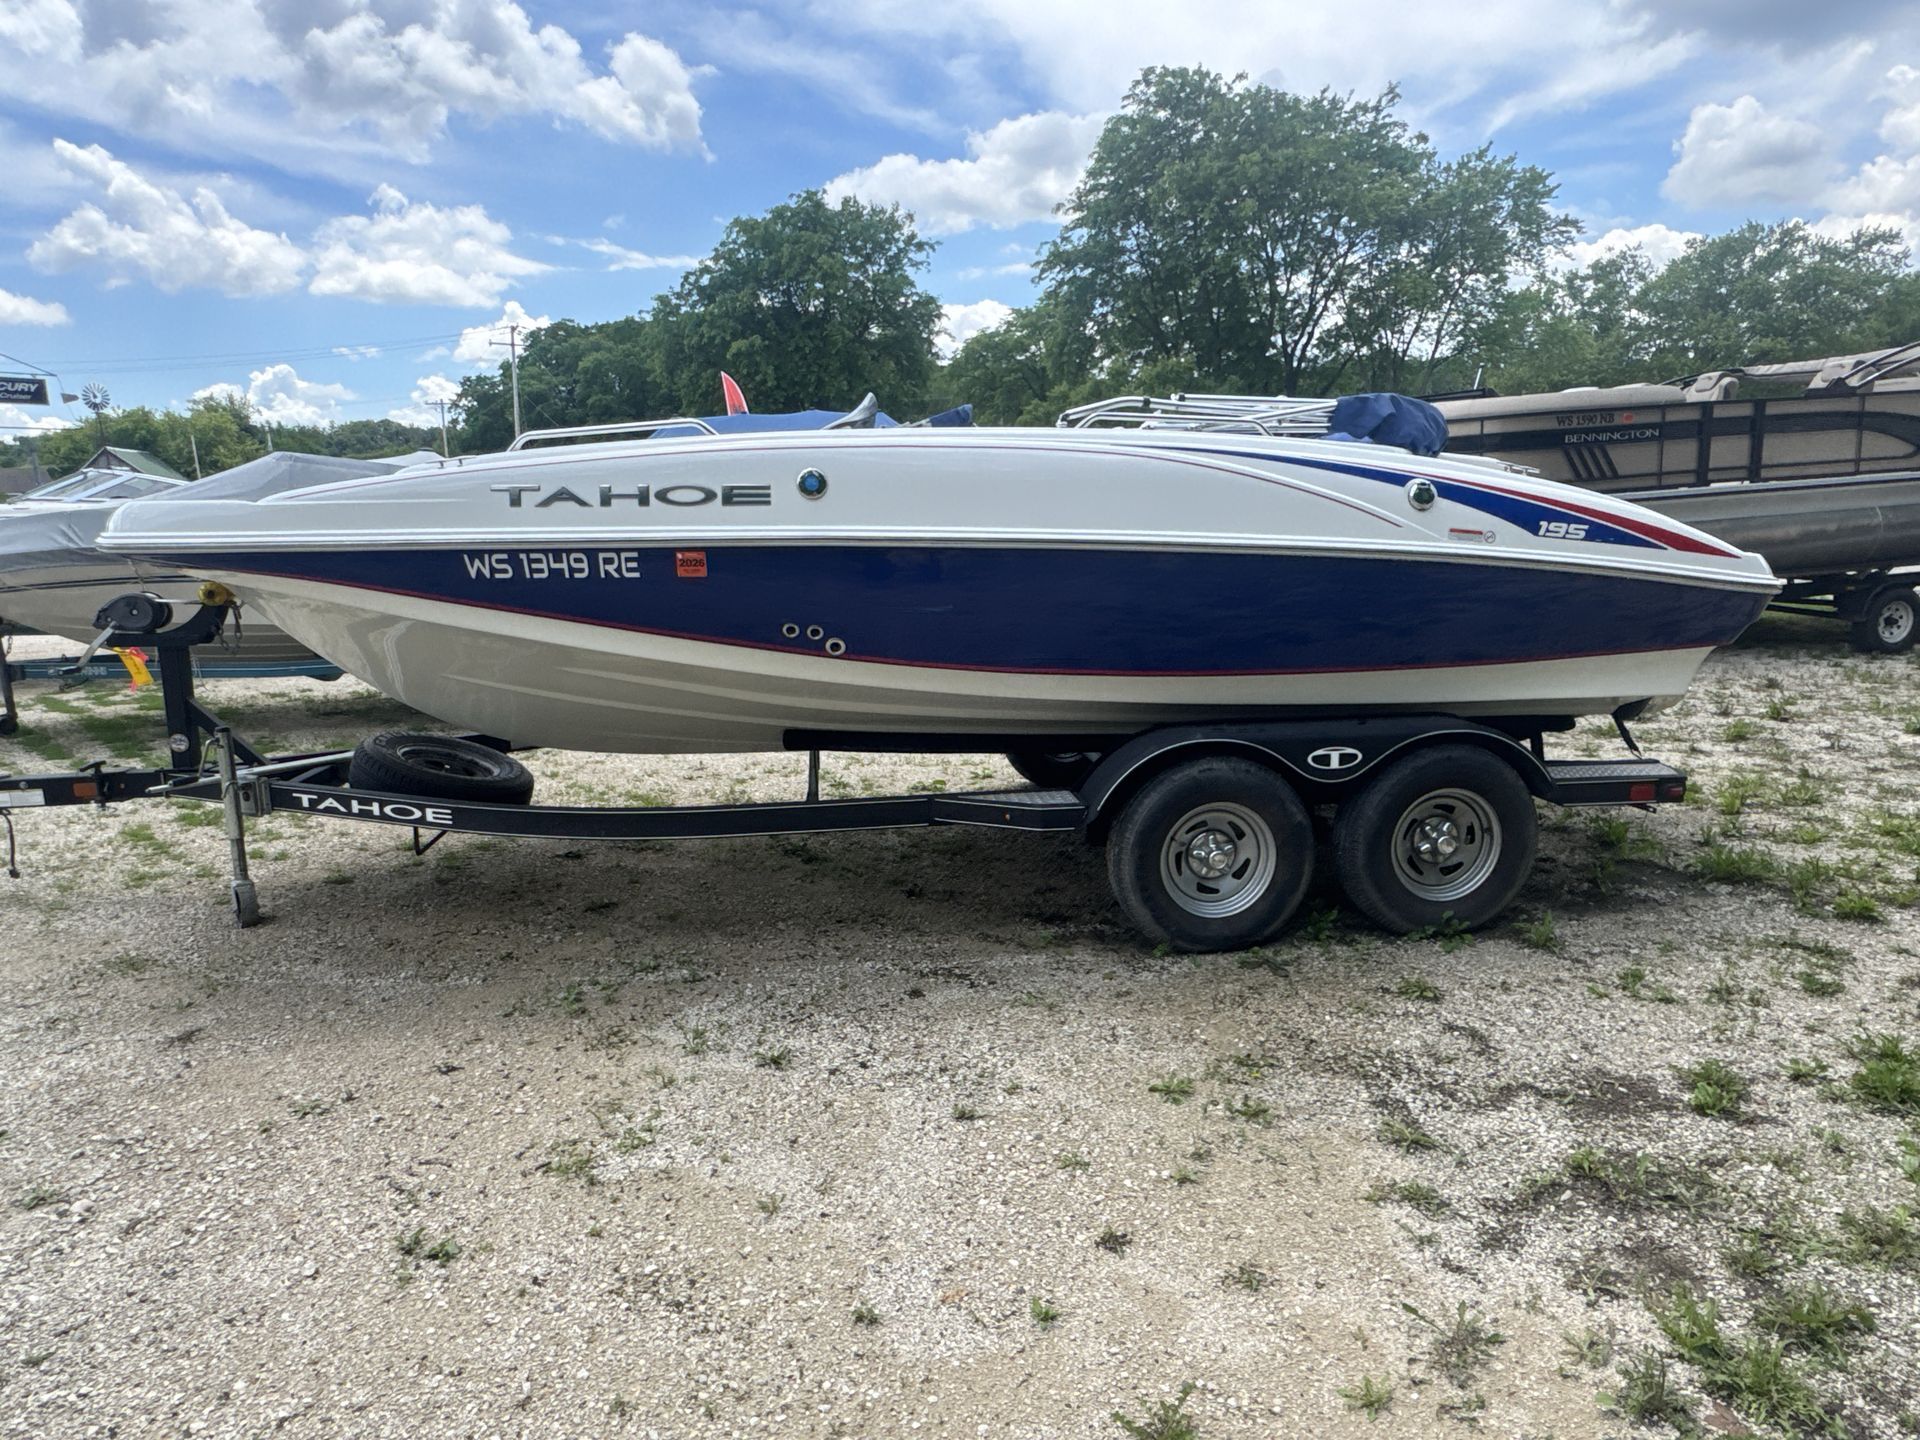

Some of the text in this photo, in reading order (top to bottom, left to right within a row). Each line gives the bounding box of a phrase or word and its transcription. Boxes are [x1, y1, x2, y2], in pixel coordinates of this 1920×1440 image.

[1556, 415, 1574, 427] WS
[1575, 414, 1597, 426] 1590
[1564, 428, 1660, 443] BENNINGTON
[489, 484, 772, 508] TAHOE
[1537, 521, 1590, 540] 195
[463, 552, 642, 579] WS 1349 RE
[678, 558, 706, 568] 2026
[291, 792, 454, 825] TAHOE
